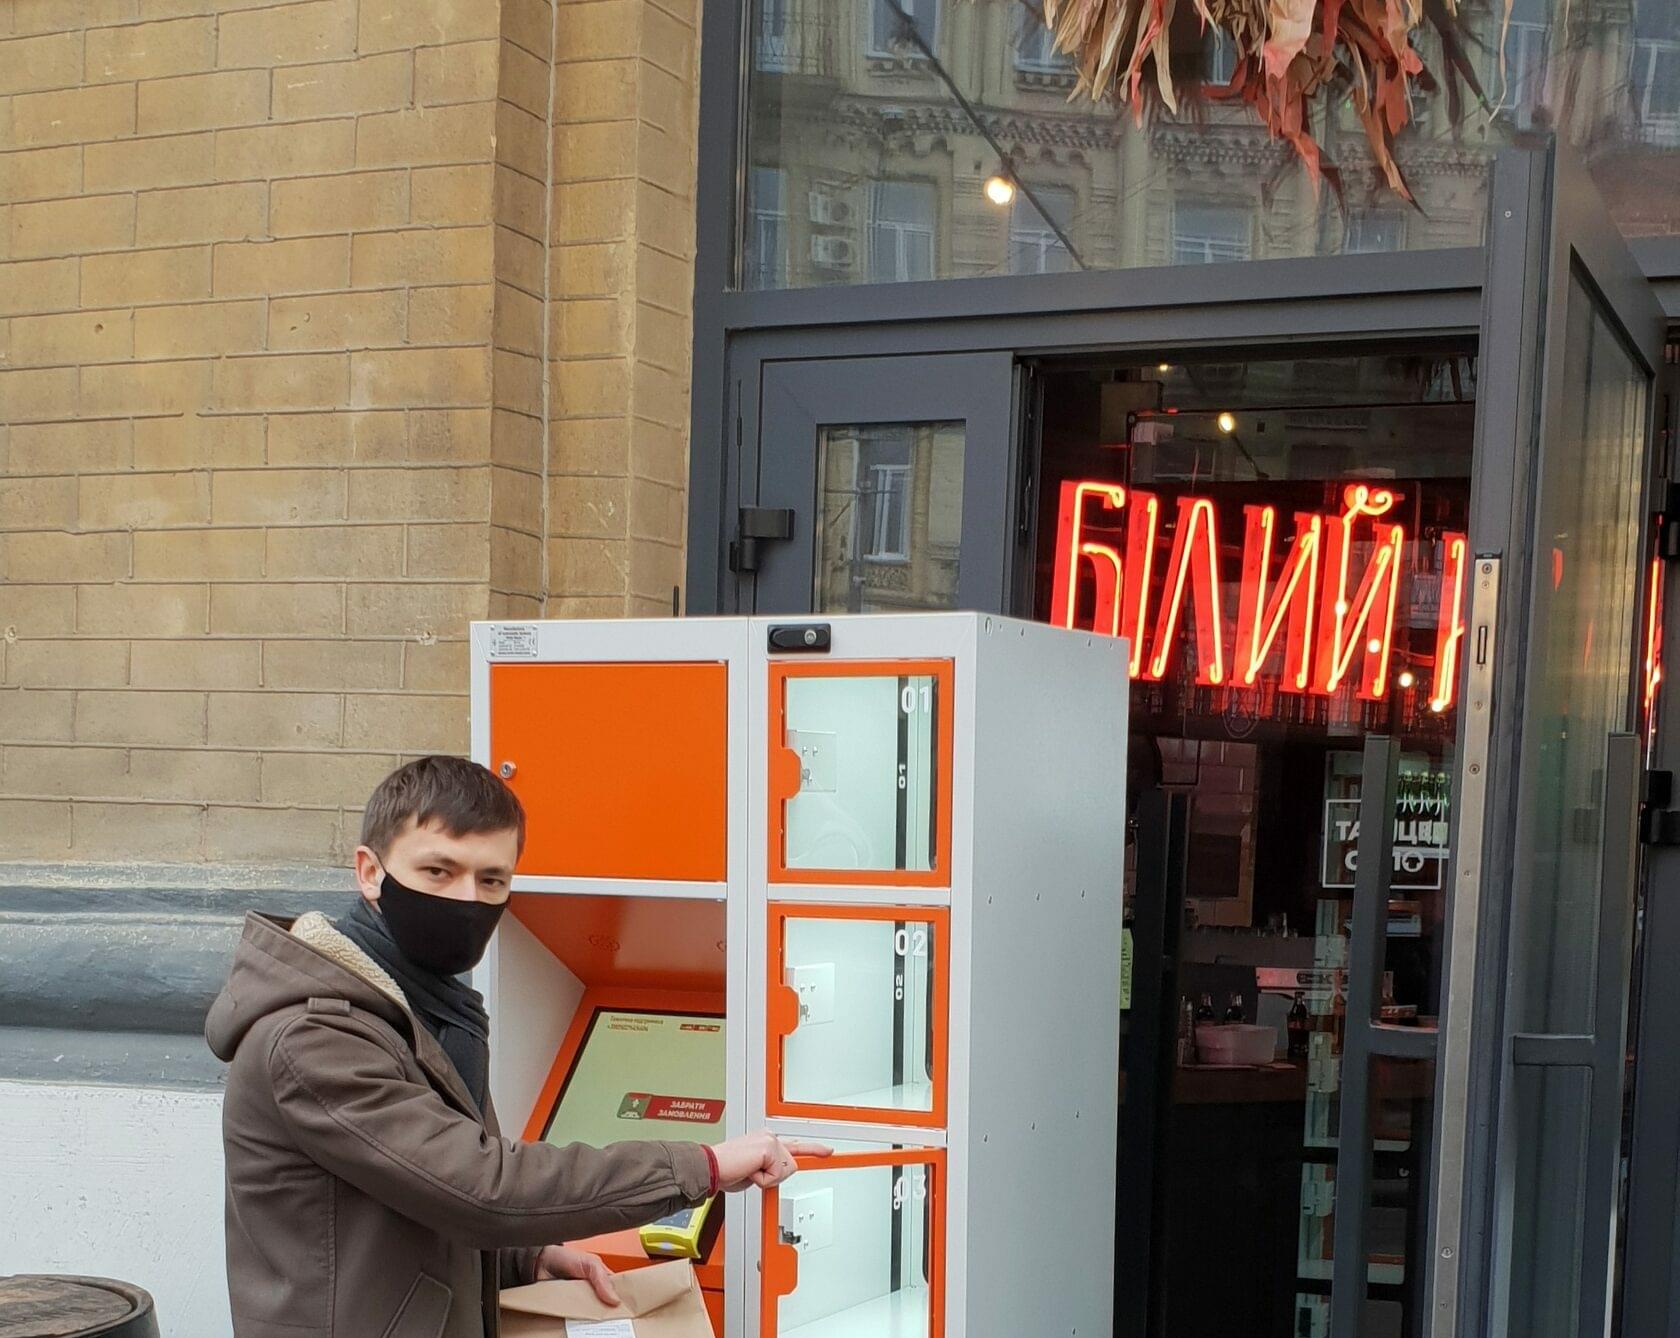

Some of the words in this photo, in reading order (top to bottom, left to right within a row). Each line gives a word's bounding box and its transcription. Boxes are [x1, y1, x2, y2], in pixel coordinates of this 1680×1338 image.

[1050, 481, 1404, 701] БІЛИЙ
[901, 686, 929, 713] 01
[895, 929, 928, 957] 02
[669, 1100, 706, 1110] ЗАБРАТИ
